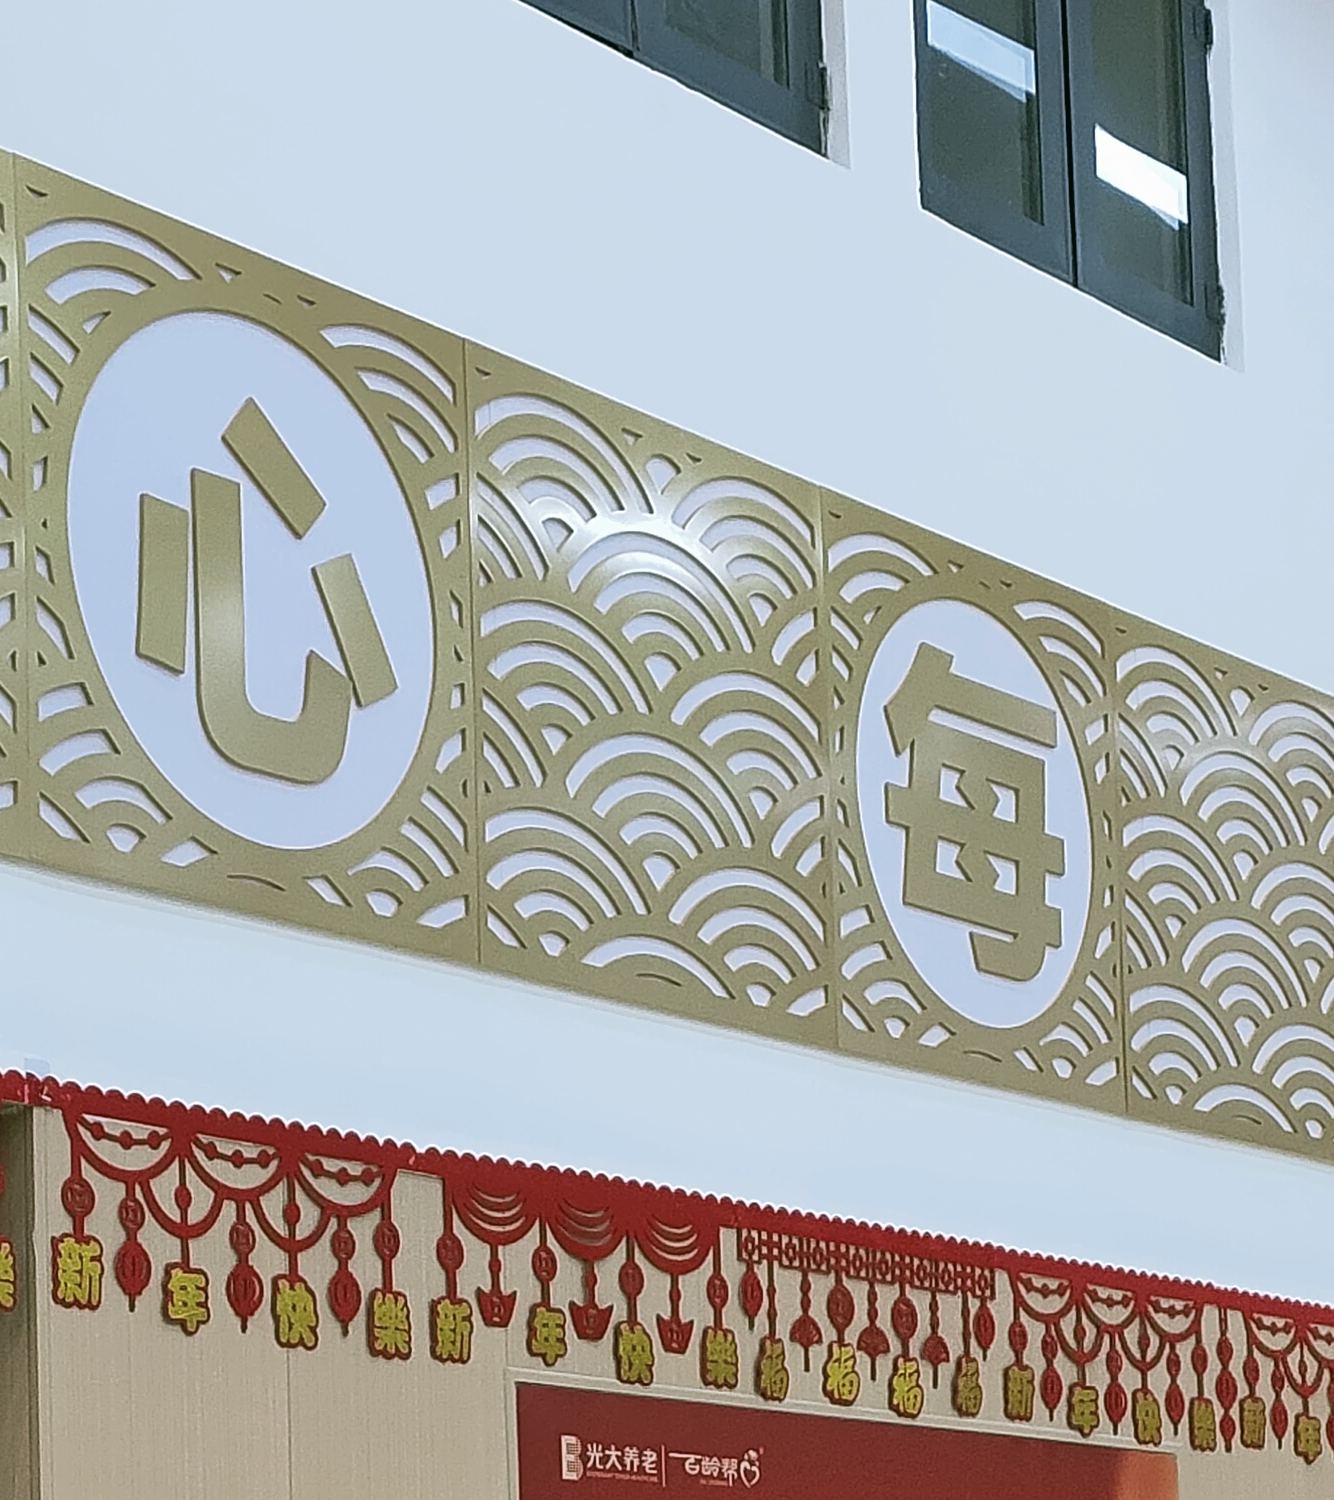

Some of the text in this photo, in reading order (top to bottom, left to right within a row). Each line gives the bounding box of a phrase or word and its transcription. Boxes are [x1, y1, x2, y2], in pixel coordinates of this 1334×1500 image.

[137, 396, 399, 786] 心
[883, 640, 1065, 982] 每
[57, 1237, 103, 1307] 新
[165, 1267, 210, 1334] 年
[274, 1279, 320, 1346] 快
[825, 1342, 861, 1401] 福
[890, 1357, 924, 1416] 福
[586, 1442, 659, 1475] 光大养老
